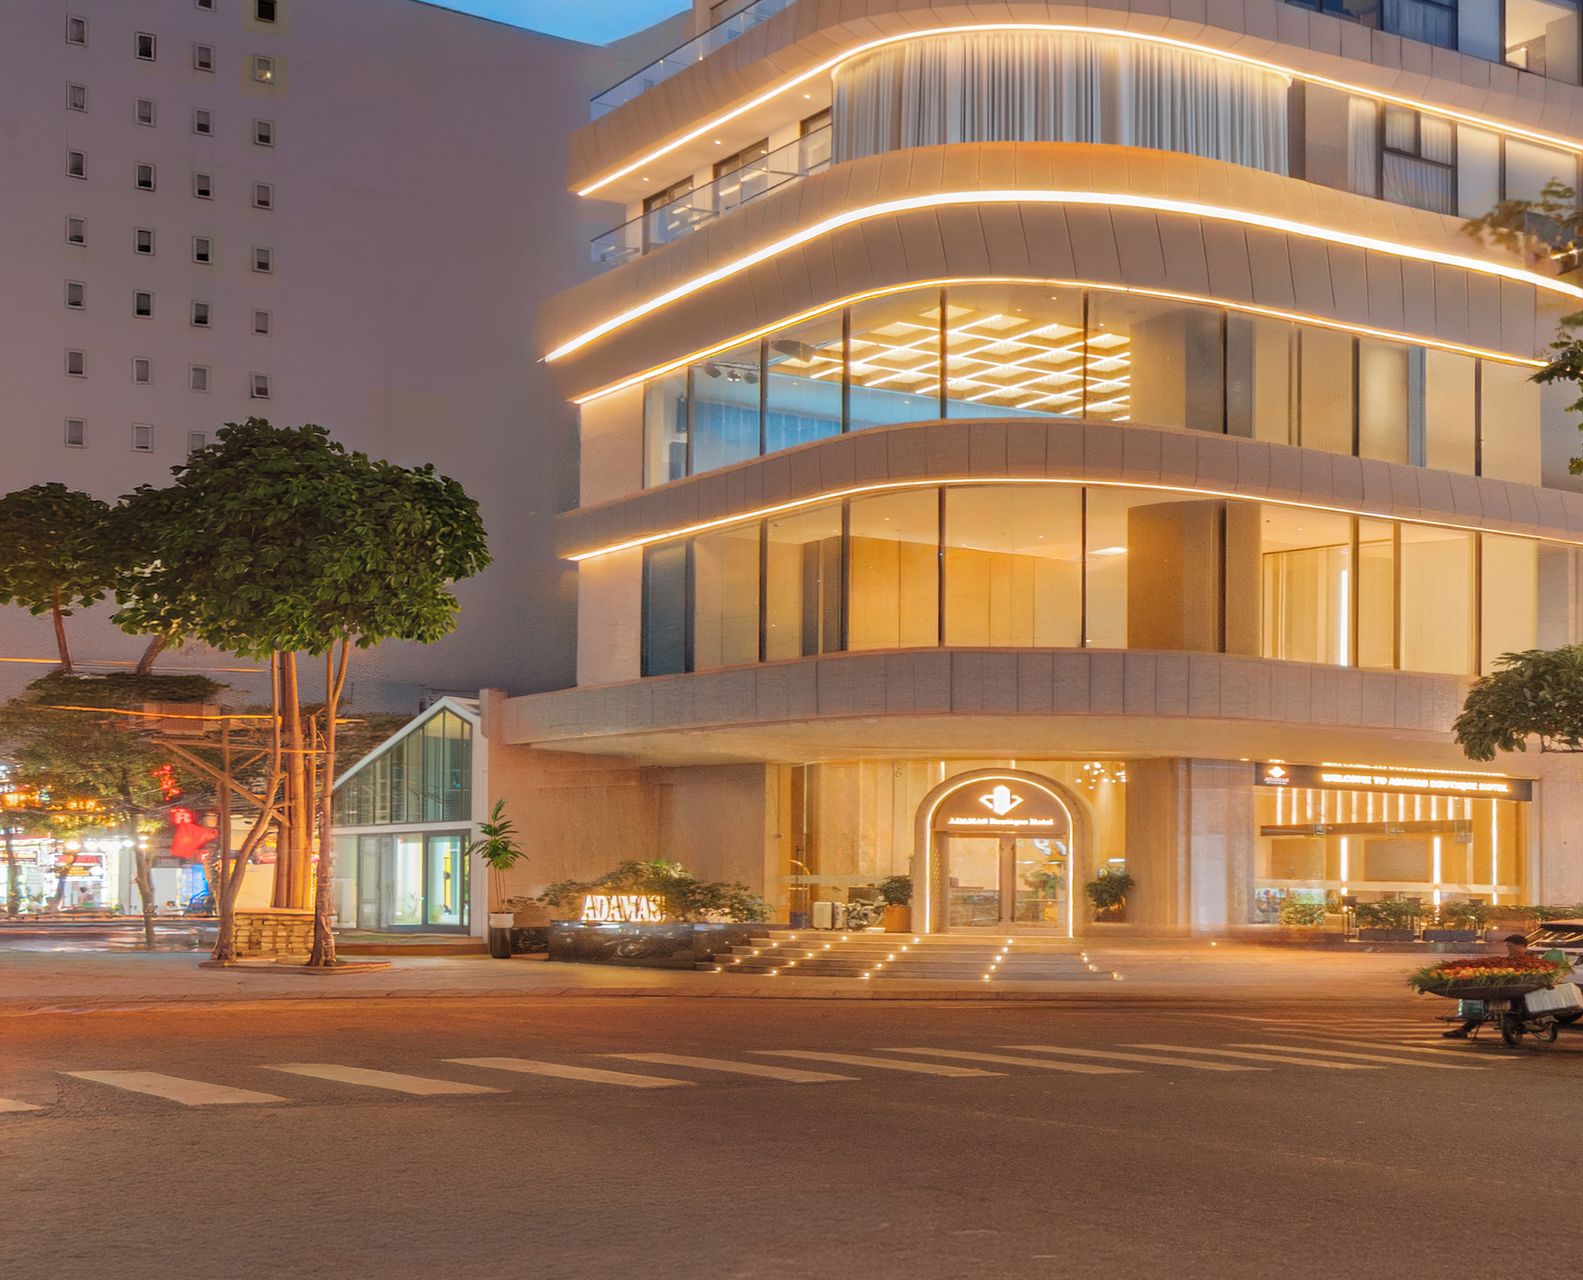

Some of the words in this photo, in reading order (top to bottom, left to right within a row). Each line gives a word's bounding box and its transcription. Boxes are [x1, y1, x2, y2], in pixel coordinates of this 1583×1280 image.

[1321, 773, 1372, 785] WELCOME
[1373, 775, 1388, 785] TO
[1479, 782, 1509, 793] HOTEL
[581, 895, 664, 922] ADAMAS
